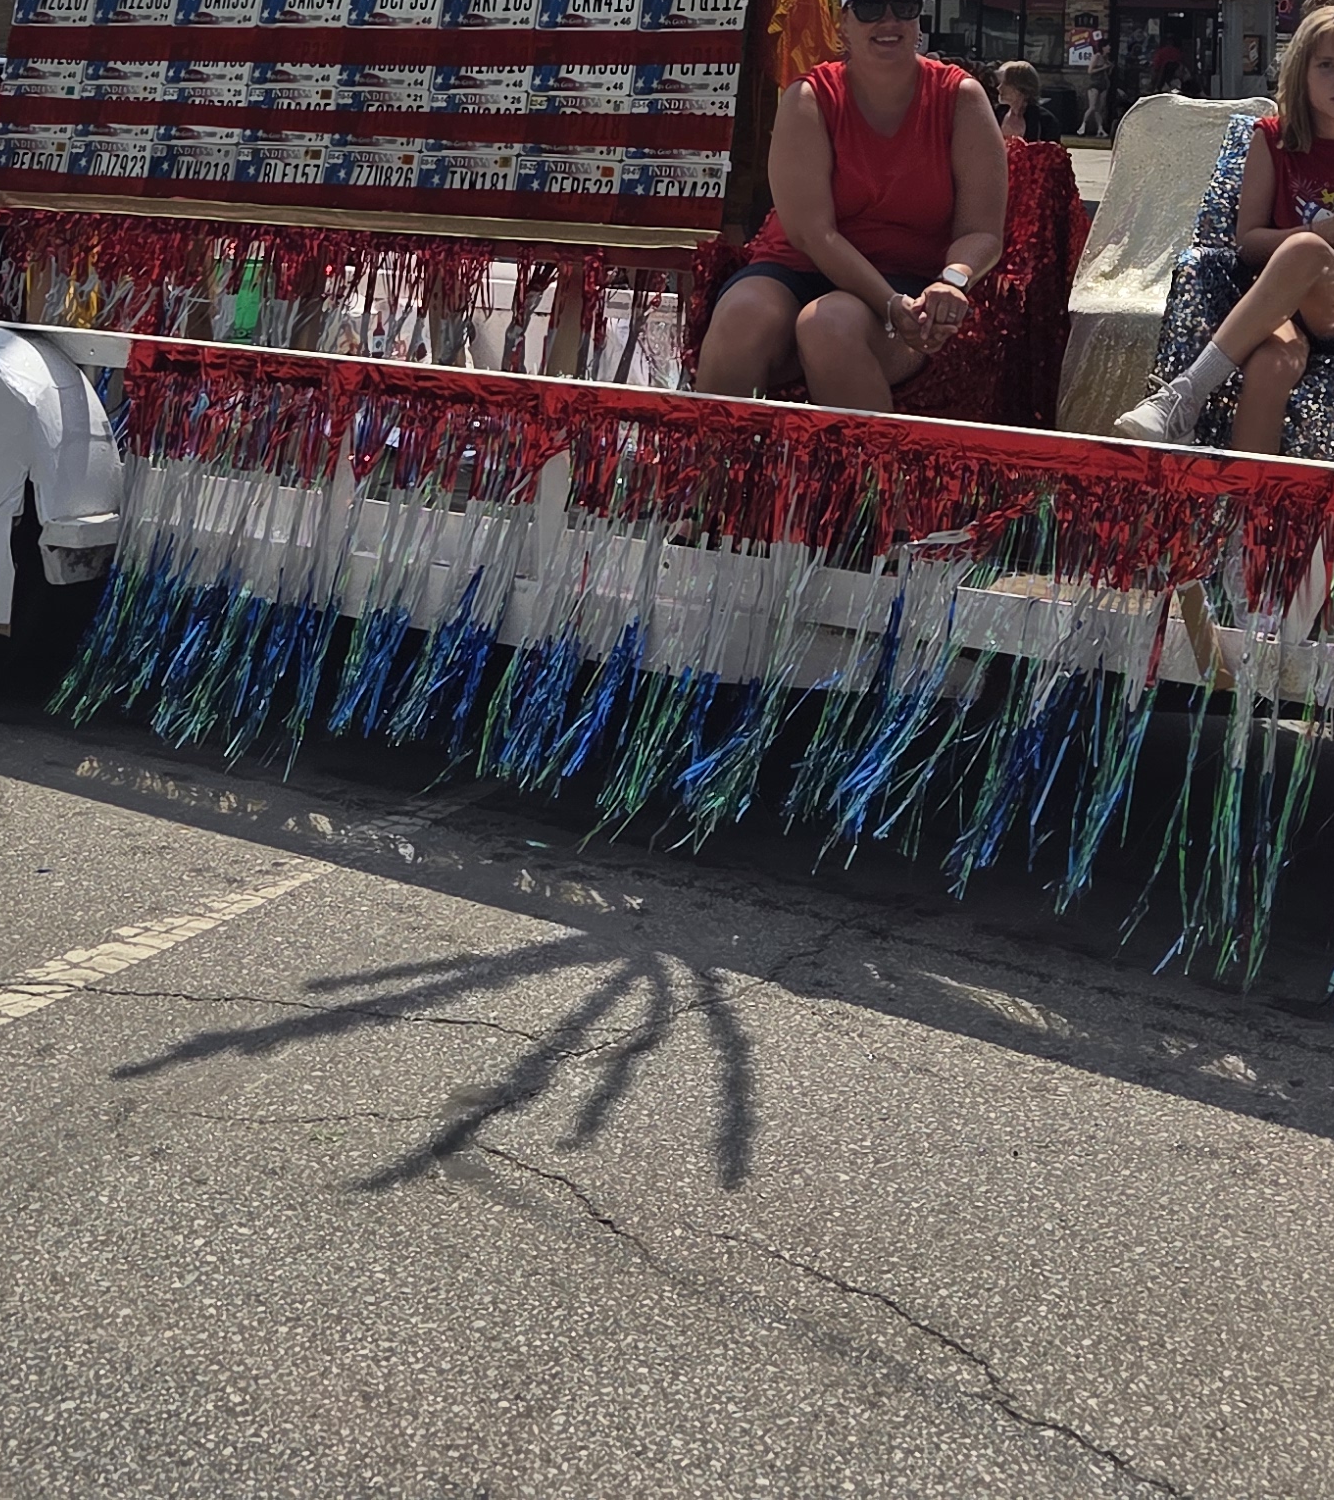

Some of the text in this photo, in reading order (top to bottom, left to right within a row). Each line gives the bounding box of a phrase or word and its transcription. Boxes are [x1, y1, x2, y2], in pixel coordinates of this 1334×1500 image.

[612, 81, 624, 90] 46
[718, 82, 730, 91] 46
[455, 94, 501, 104] INDIANA
[554, 97, 602, 108] INDIANA
[657, 99, 706, 110] INDIANA
[259, 149, 301, 159] INDIANA
[350, 153, 394, 163] INDIANA
[444, 156, 489, 168] INDIANA
[544, 161, 591, 173] INDIANA
[648, 165, 697, 177] INDIANA
